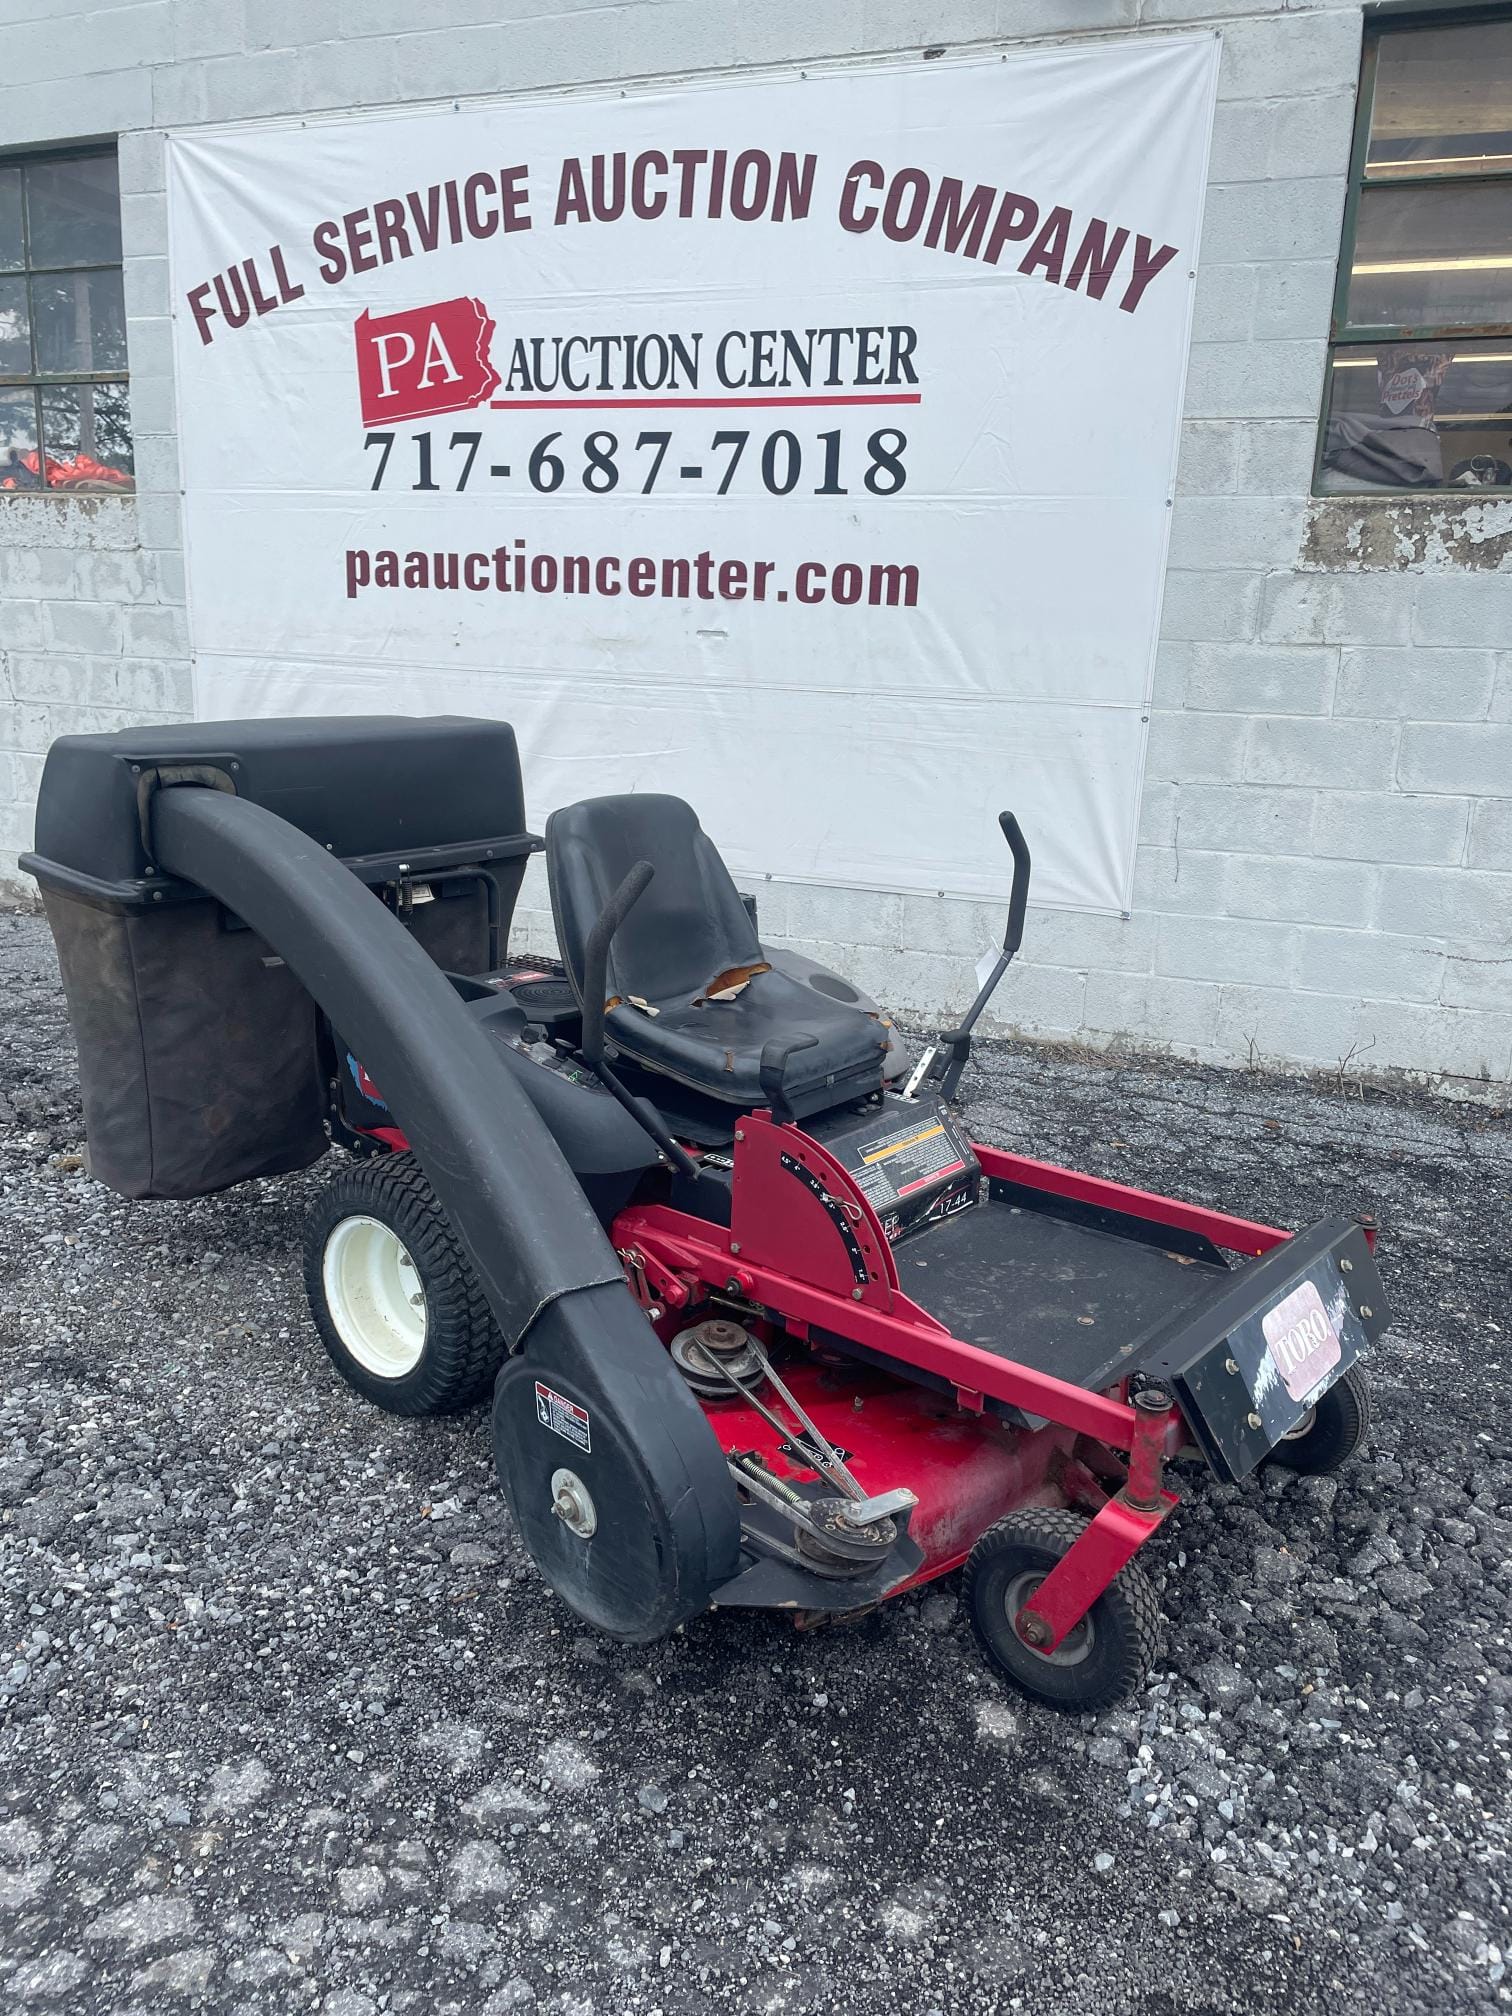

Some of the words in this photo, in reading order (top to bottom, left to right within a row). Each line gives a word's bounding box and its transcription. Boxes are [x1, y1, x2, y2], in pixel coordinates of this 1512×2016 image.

[186, 244, 305, 346] FULL
[312, 164, 532, 285] SERVICE
[553, 148, 818, 226] AUCTION
[838, 159, 1180, 314] COMPANY
[370, 321, 463, 399] PA
[505, 332, 703, 392] AUCTION
[715, 325, 920, 389] CENTER
[363, 428, 908, 496] 717-687-7018
[345, 538, 920, 607] paauctioncenter.com
[1274, 1308, 1329, 1375] TORO
